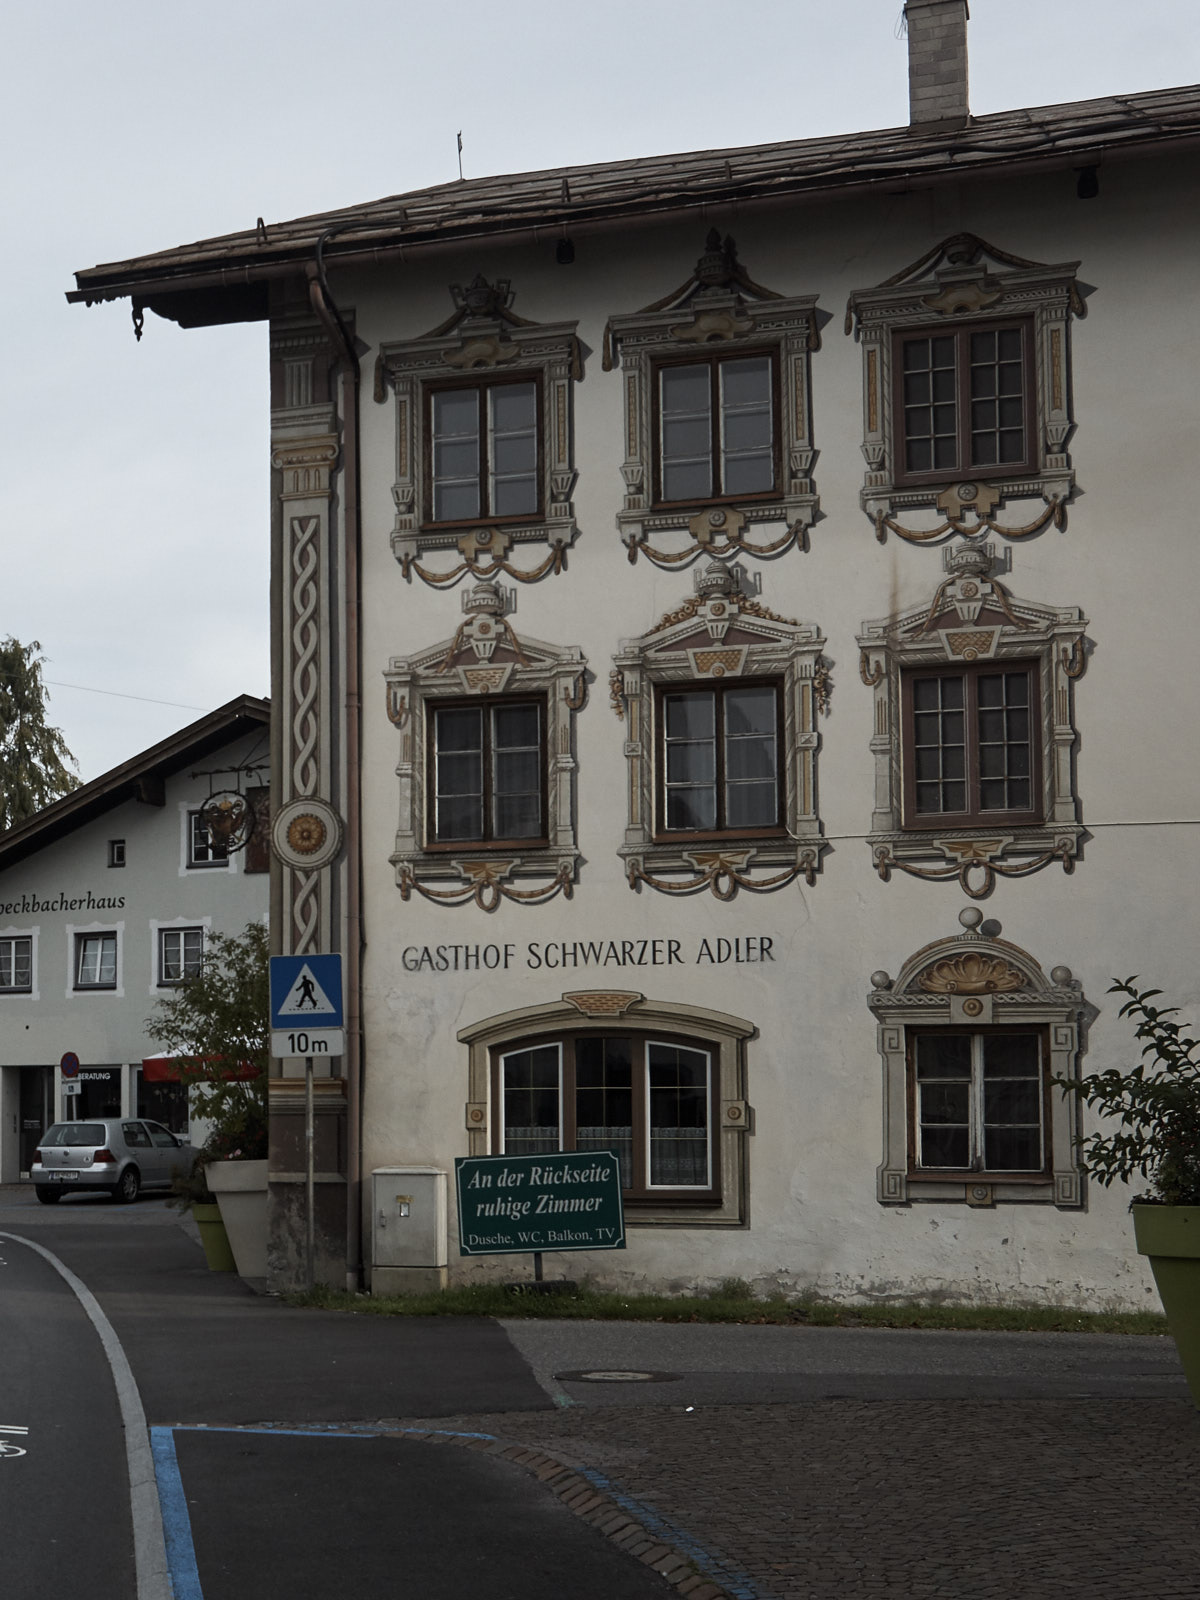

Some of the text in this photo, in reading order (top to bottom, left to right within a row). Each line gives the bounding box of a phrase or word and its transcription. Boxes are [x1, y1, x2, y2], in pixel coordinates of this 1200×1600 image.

[402, 936, 776, 972] GASTHOF SCHWARZER ADLER
[77, 1072, 111, 1081] BERATUNG
[467, 1164, 611, 1189] An der Rückseite
[476, 1195, 603, 1221] ruhige Zimmer
[468, 1228, 615, 1247] Dusche, WC, Balkon, TV
